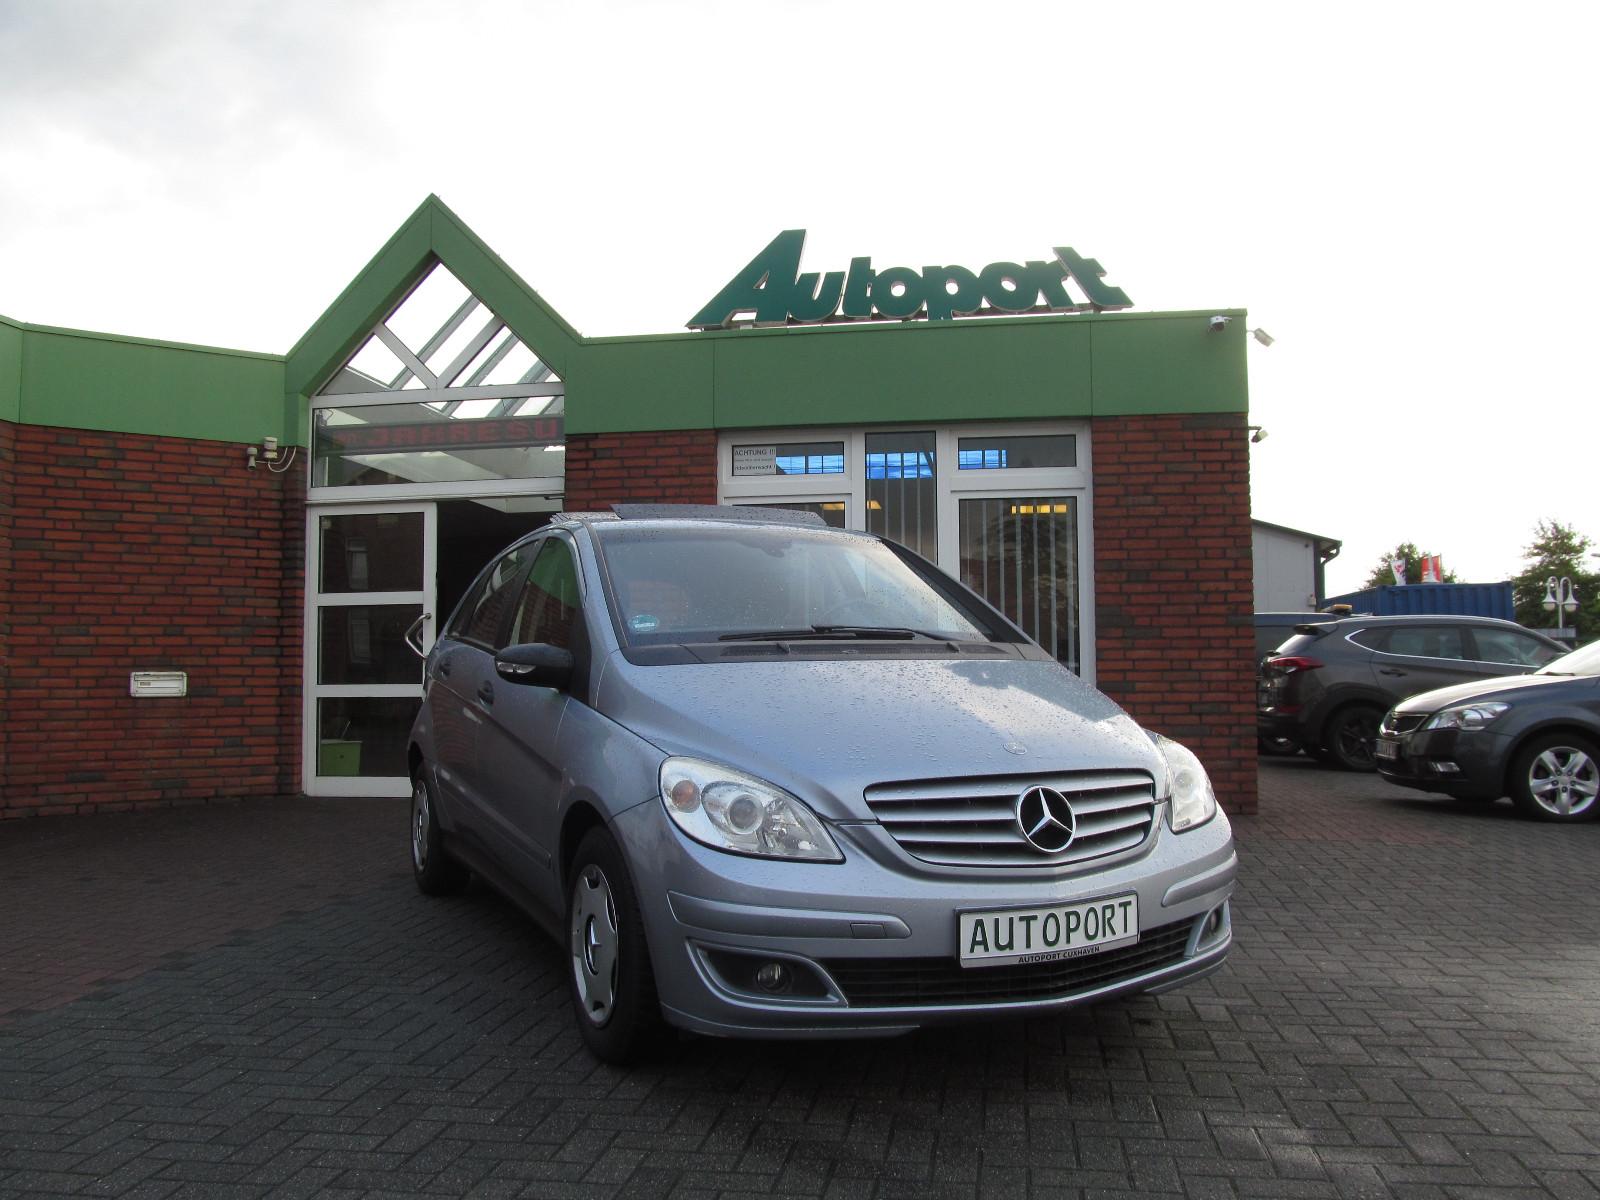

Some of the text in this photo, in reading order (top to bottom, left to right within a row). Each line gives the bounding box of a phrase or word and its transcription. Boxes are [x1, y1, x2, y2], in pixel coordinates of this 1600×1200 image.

[685, 229, 1135, 329] Autoport
[969, 900, 1132, 954] AUTOPORT
[1018, 945, 1100, 963] AUTOPORT CUXHAVEN
